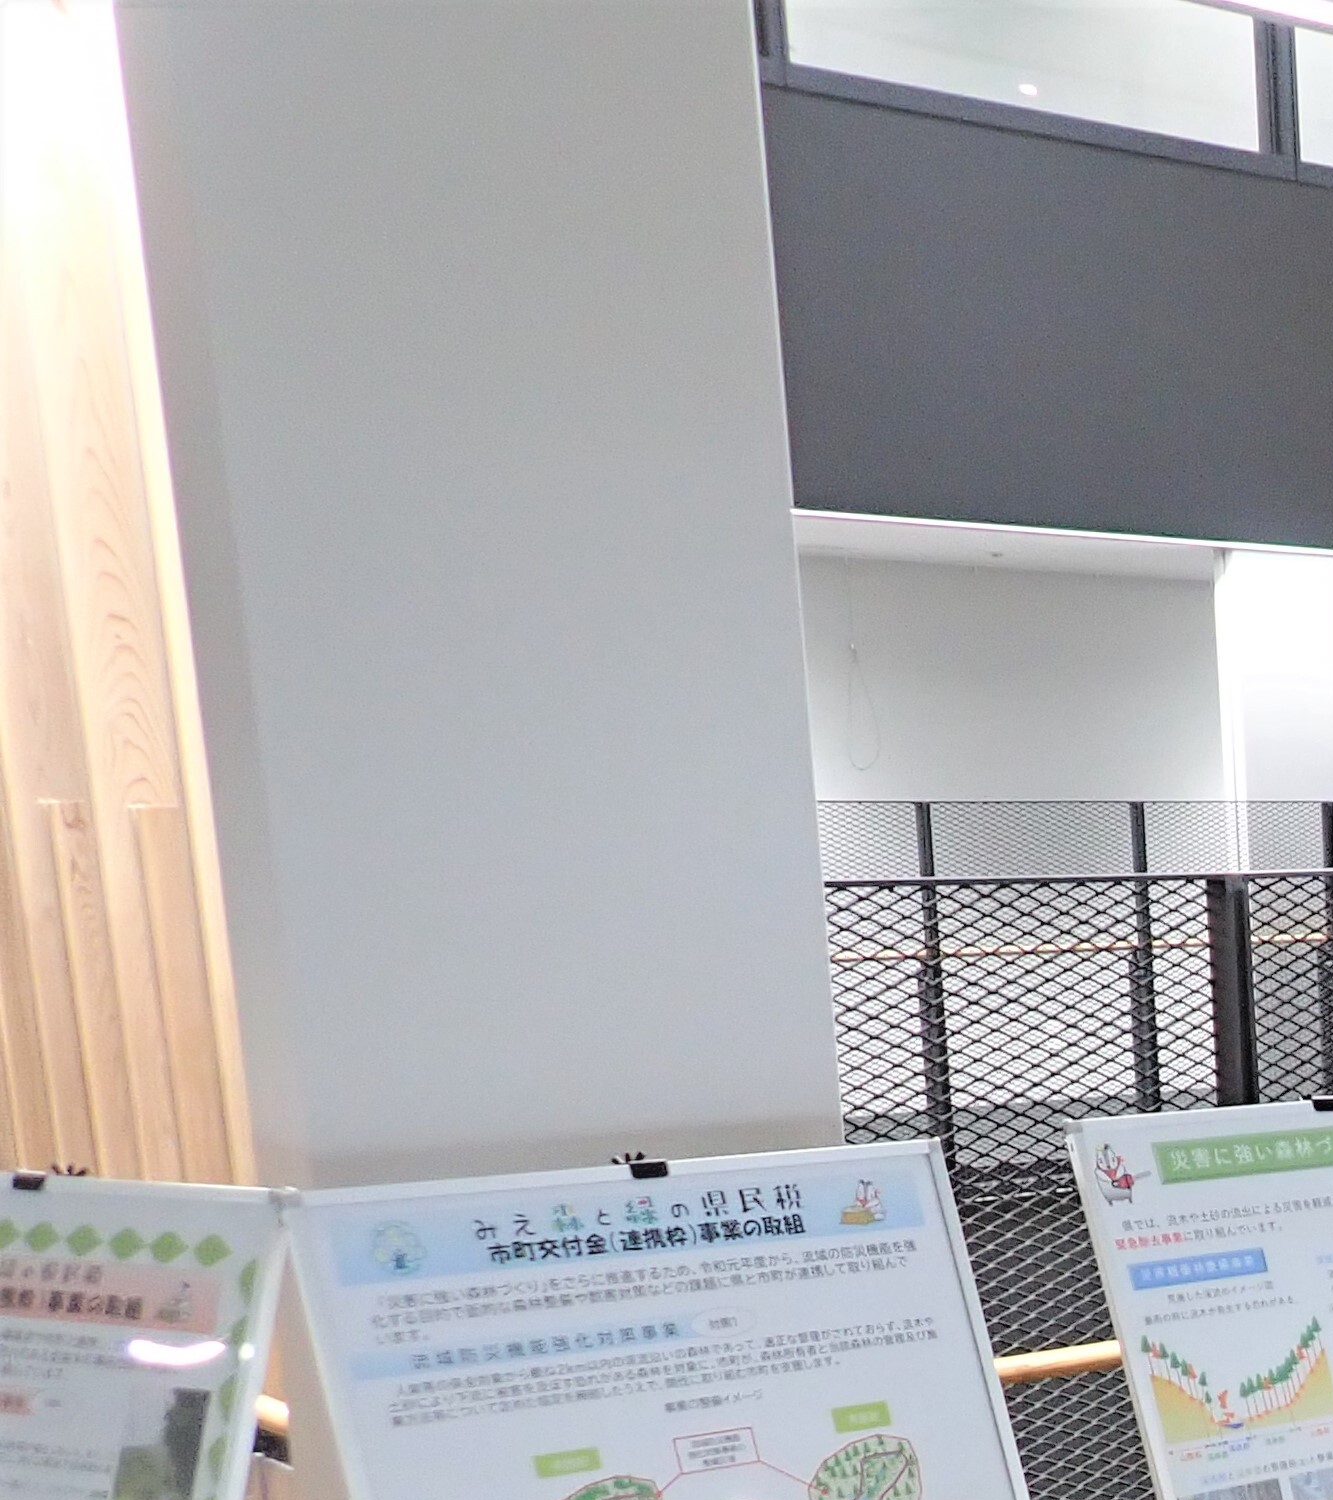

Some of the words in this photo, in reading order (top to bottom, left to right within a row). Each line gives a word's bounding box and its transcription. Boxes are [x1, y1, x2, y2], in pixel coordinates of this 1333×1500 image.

[470, 1181, 804, 1242] みえ森と緑の県民税
